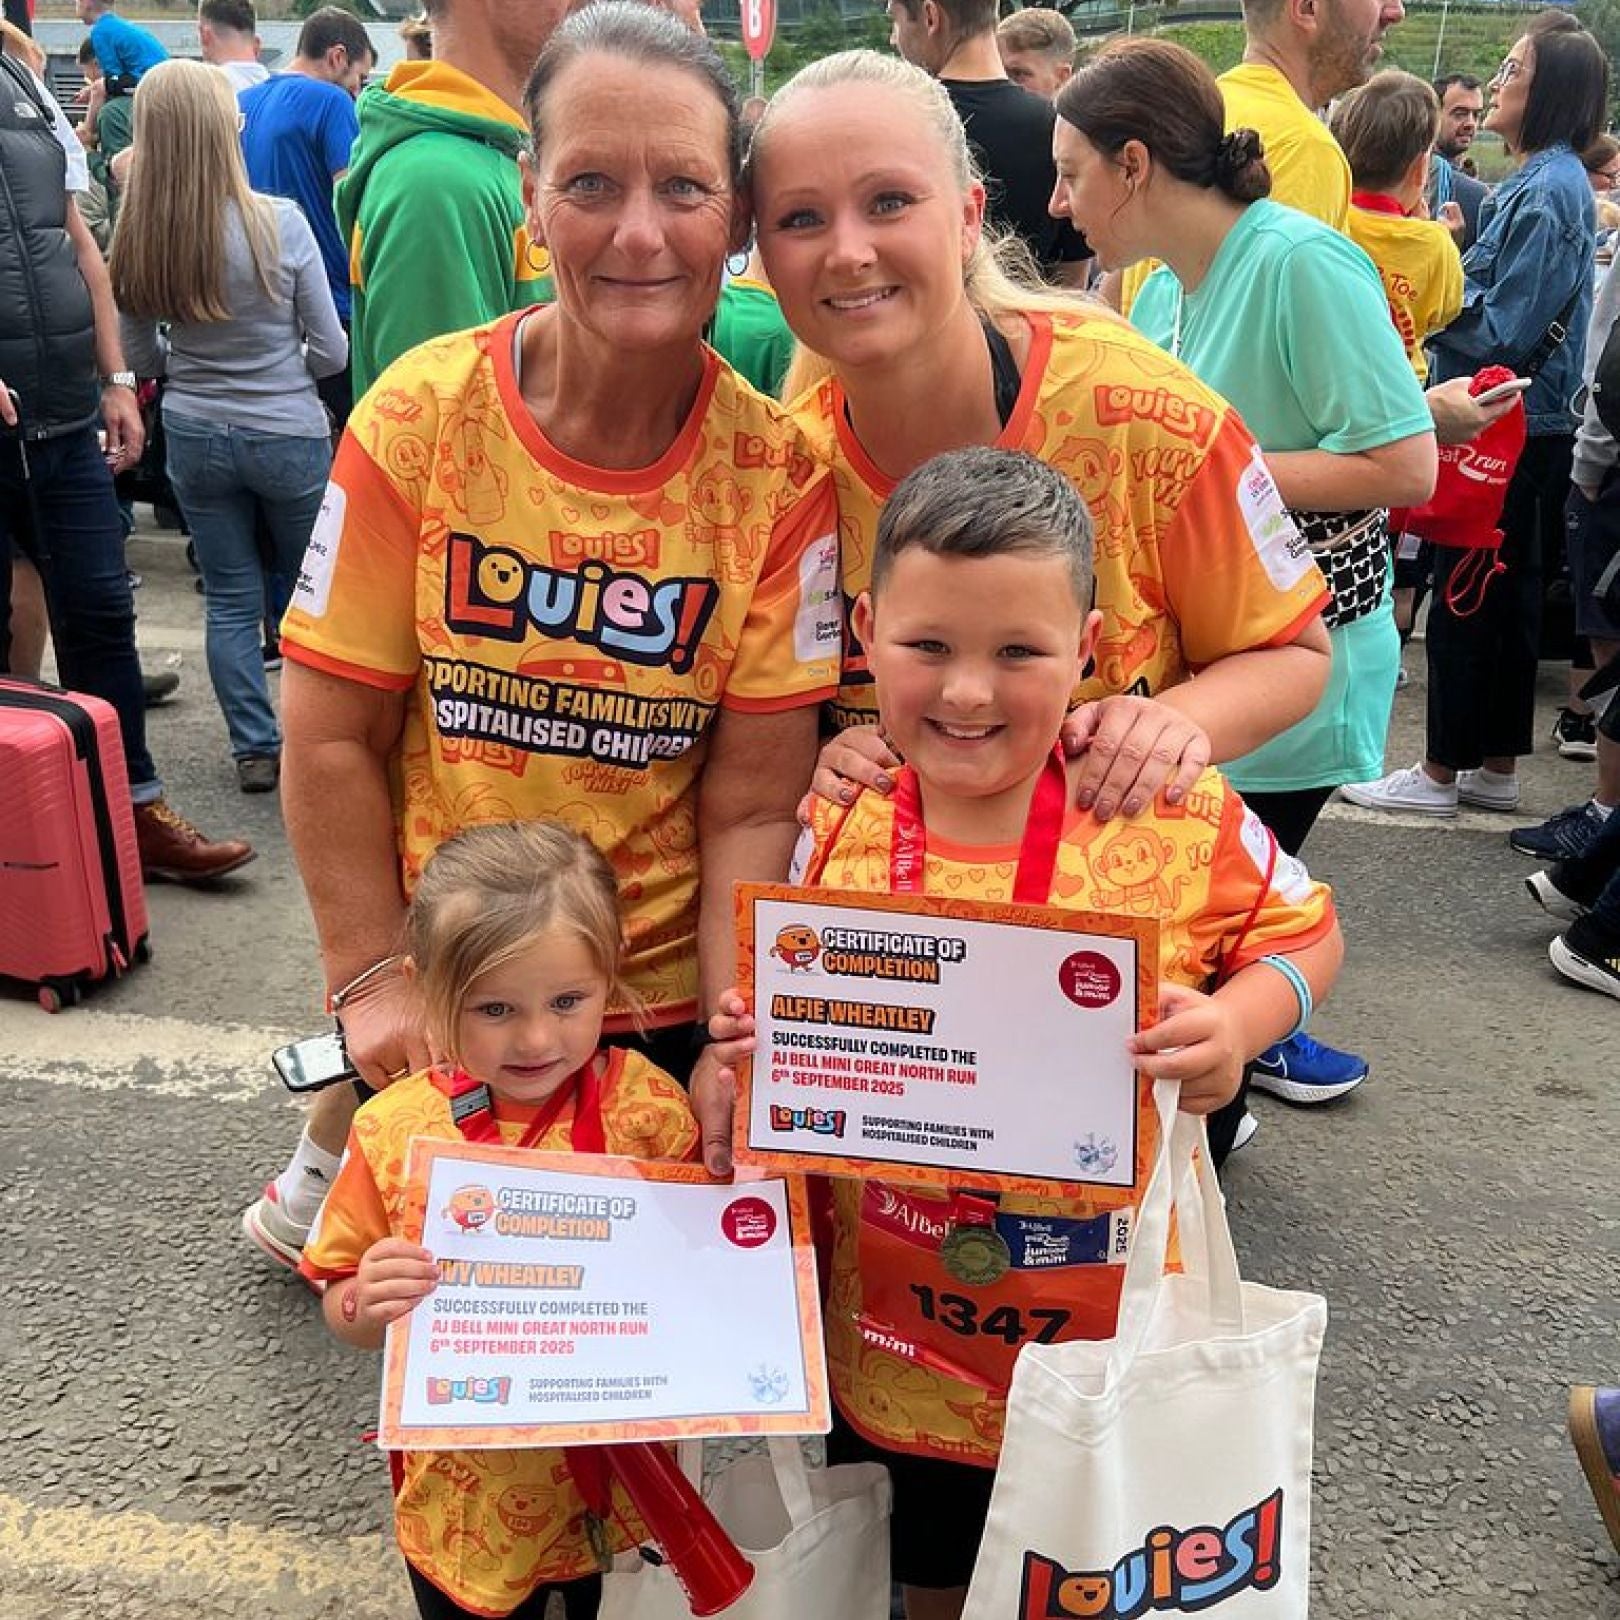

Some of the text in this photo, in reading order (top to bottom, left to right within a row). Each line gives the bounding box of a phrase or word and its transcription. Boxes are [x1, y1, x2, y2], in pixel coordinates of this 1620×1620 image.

[445, 532, 719, 674] Louies!
[432, 697, 586, 751] SPITALISED
[822, 927, 966, 962] CERTIFICATE OF
[823, 951, 940, 984] COMPLETION
[772, 995, 936, 1034] ALFIE WHEATLEY
[772, 1031, 977, 1065] SUCCESSFULLY COMPLETED THE
[772, 1052, 977, 1085] AJ BELL MINI GREAT NORTH RUN
[792, 1072, 869, 1093] SEPTEMBER
[871, 1080, 905, 1096] 2025
[770, 1104, 846, 1139] Louies!
[862, 1115, 995, 1141] SUPPORTING FAMILIES WITH
[862, 1128, 978, 1151] HOSPITALISED CHILDREN
[498, 1188, 635, 1219] CERTIFICATE OF
[496, 1213, 611, 1241] COMPLETION
[474, 1262, 584, 1289] WHEATLEY
[433, 1298, 648, 1316] SUCCESSFULLY COMPLETED THE
[909, 1282, 1071, 1344] 1347
[432, 1319, 649, 1336] AJ BELL MINI GREAT NORTH RUN
[453, 1339, 537, 1354] SEPTEMBER
[540, 1340, 575, 1354] 2025
[426, 1376, 512, 1405] Louies!
[529, 1378, 594, 1390] SUPPORTING
[596, 1376, 641, 1388] FAMILIES
[529, 1389, 653, 1403] HOSPITALISED CHILDREN
[1019, 1487, 1284, 1620] Louies!
